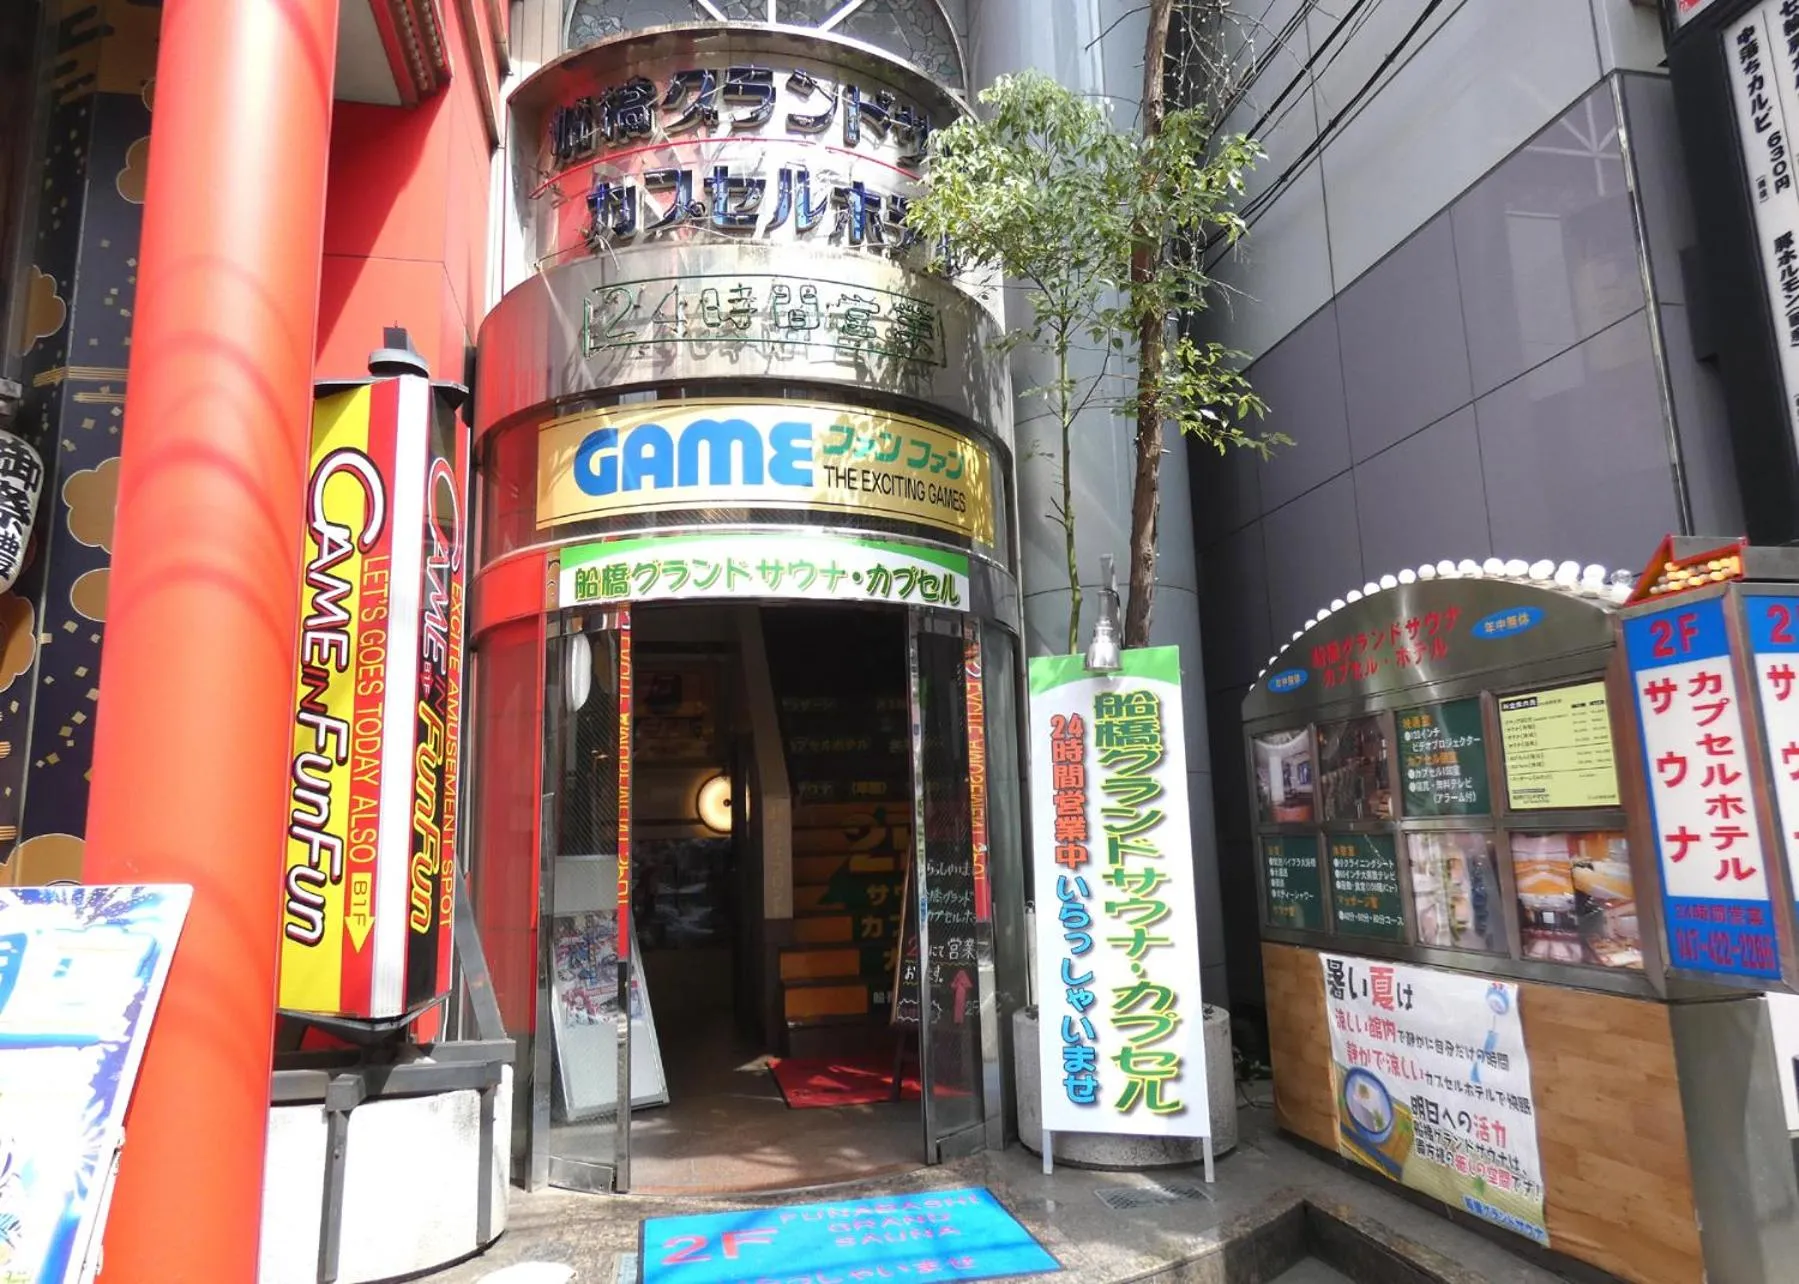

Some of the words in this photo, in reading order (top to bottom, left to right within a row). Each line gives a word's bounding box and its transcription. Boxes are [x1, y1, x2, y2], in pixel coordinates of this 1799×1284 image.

[1767, 130, 1791, 195] 630円
[573, 418, 814, 497] GAME
[823, 465, 860, 491] THE
[861, 469, 926, 502] EXCITING
[928, 483, 967, 513] GAMES
[360, 553, 389, 623] LET'S
[575, 558, 960, 605] 船橋グランドサウナ・カプセル
[447, 581, 464, 673] EXCITE
[1650, 612, 1700, 659] 2F
[1766, 604, 1799, 644] 2
[357, 629, 387, 696] GOES
[352, 704, 384, 787] TODAY
[441, 676, 460, 850] AMUSEMENT
[1643, 677, 1701, 864] サウナ
[1688, 670, 1757, 881] カプセルホテル
[349, 794, 378, 864] ALSO
[353, 880, 368, 927] B1F
[439, 859, 454, 930] SPOT
[1093, 690, 1185, 1115] 船橋グランドサウナ・カプセル
[660, 1227, 778, 1267] 2F
